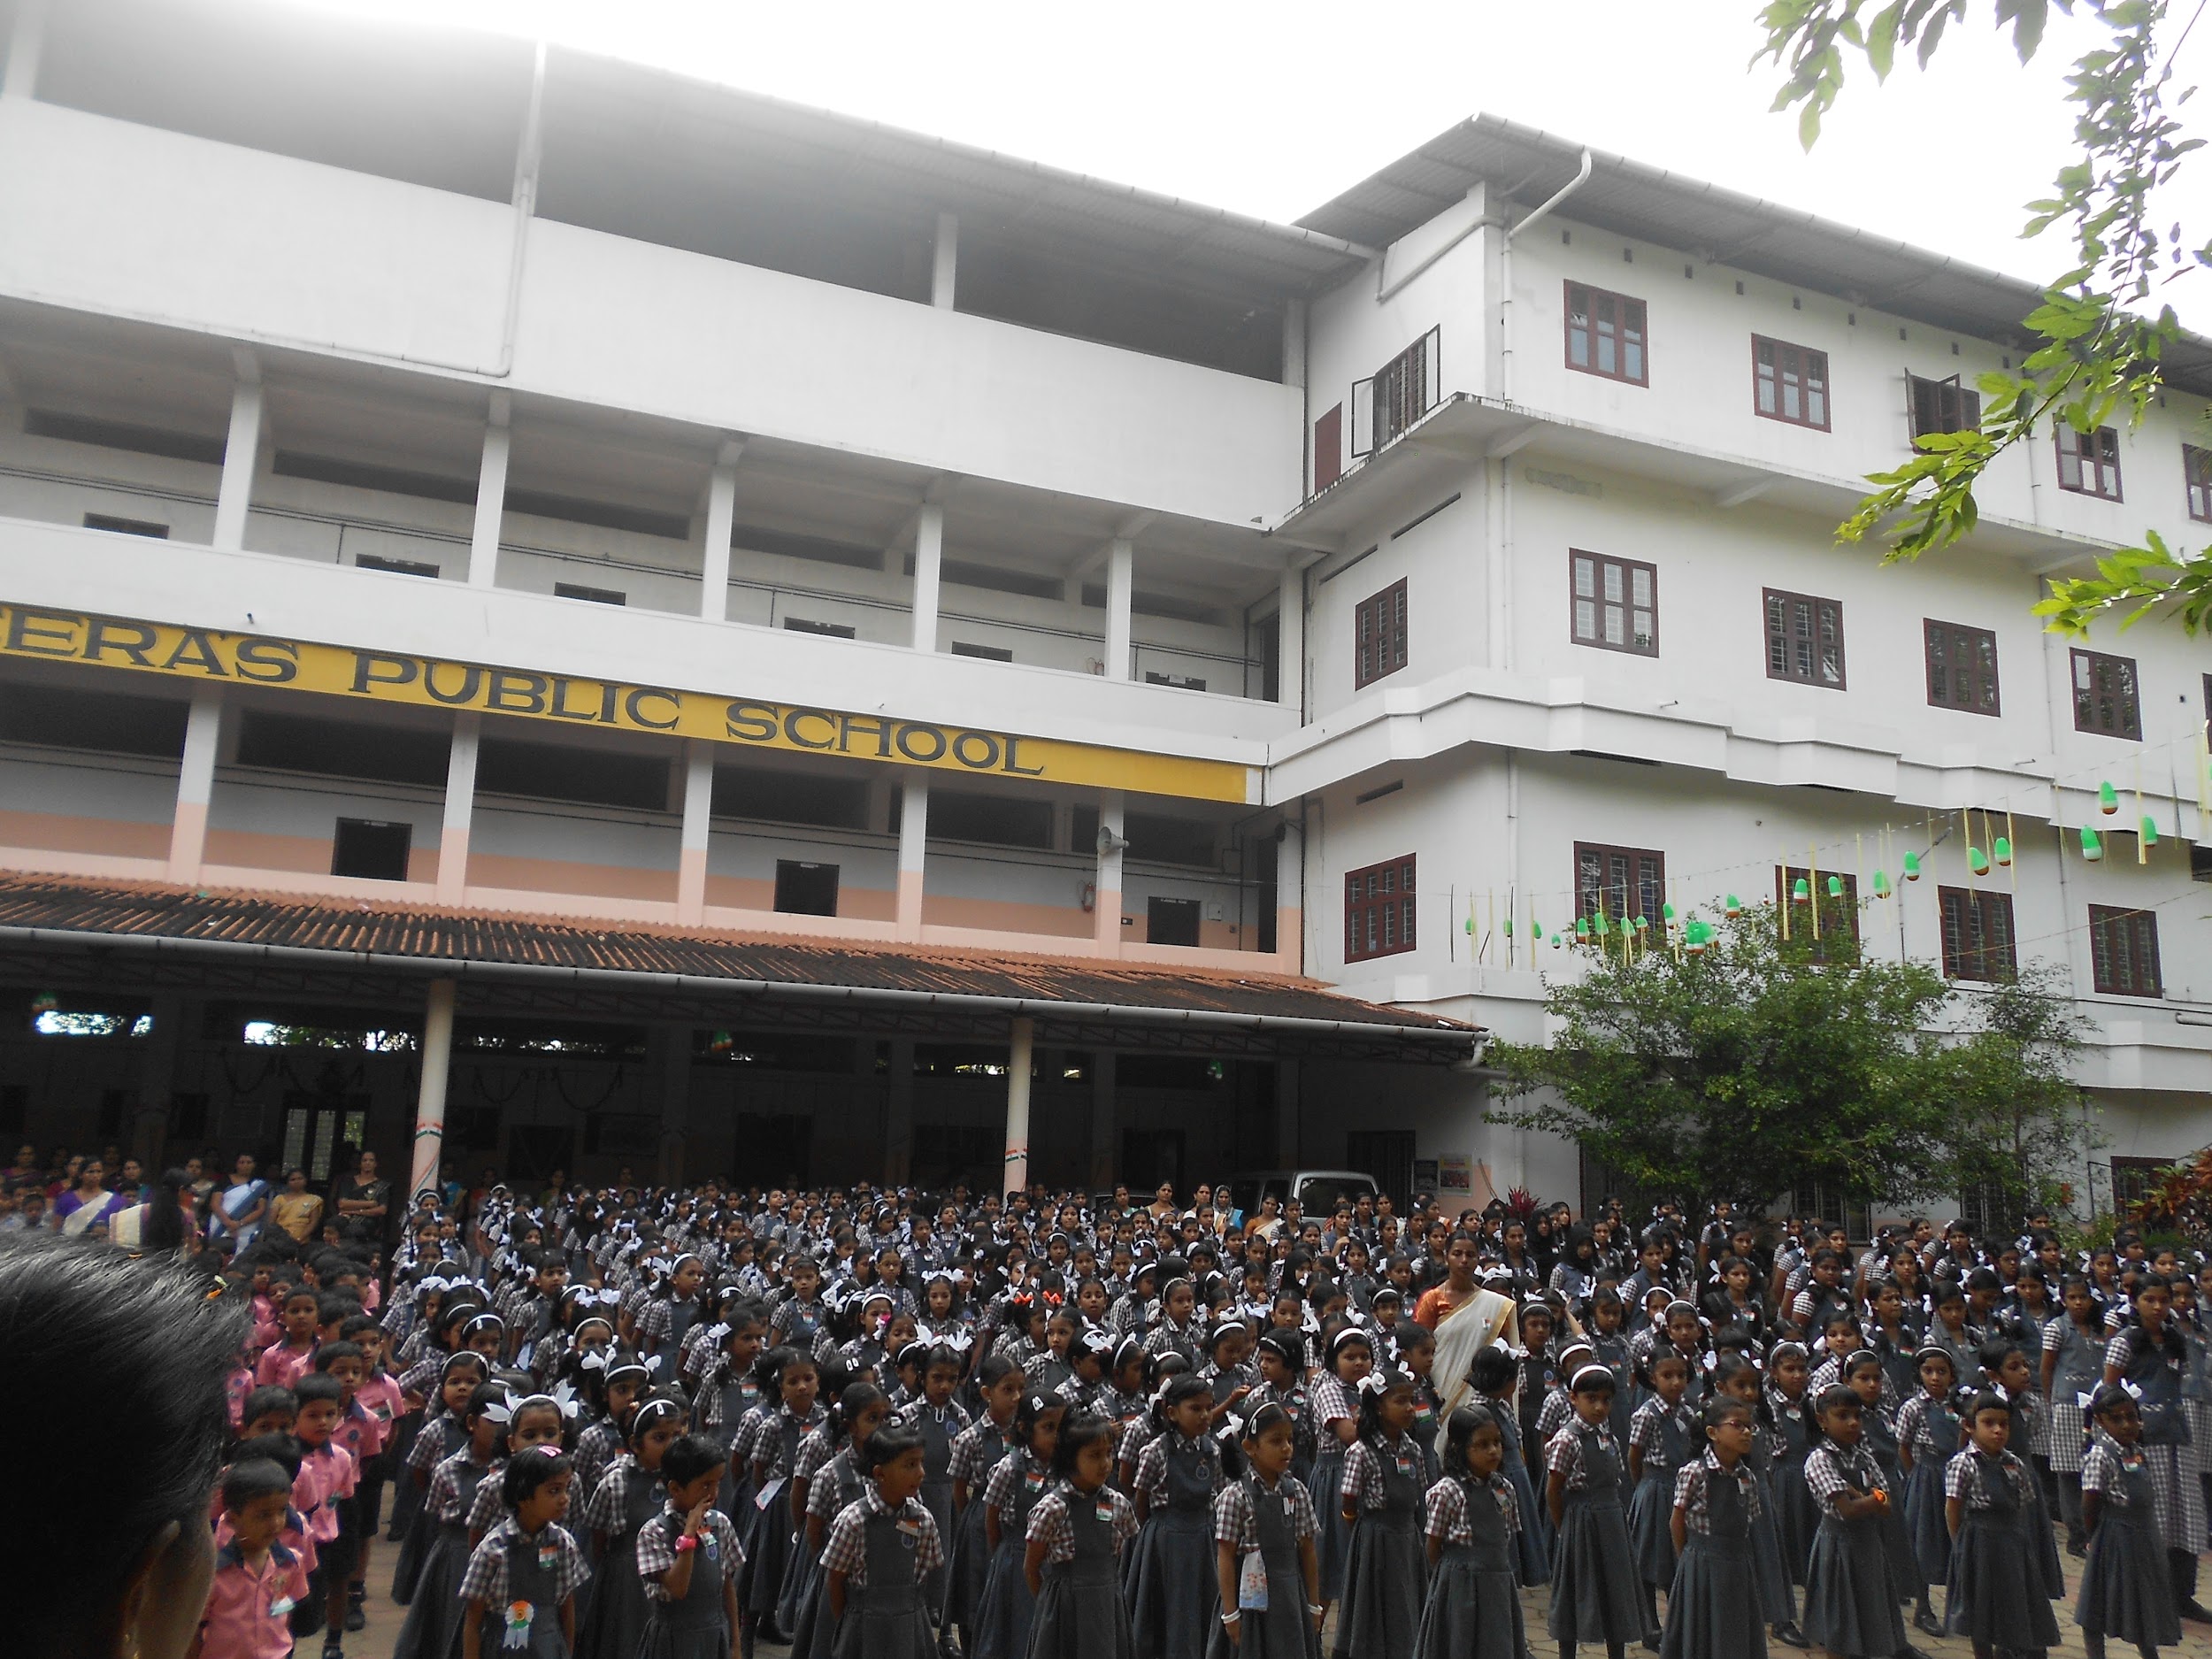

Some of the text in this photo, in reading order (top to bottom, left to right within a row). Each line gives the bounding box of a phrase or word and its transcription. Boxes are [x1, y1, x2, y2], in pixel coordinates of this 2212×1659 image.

[0, 606, 1045, 776] ERA'S PUBLIC SCHOOL
